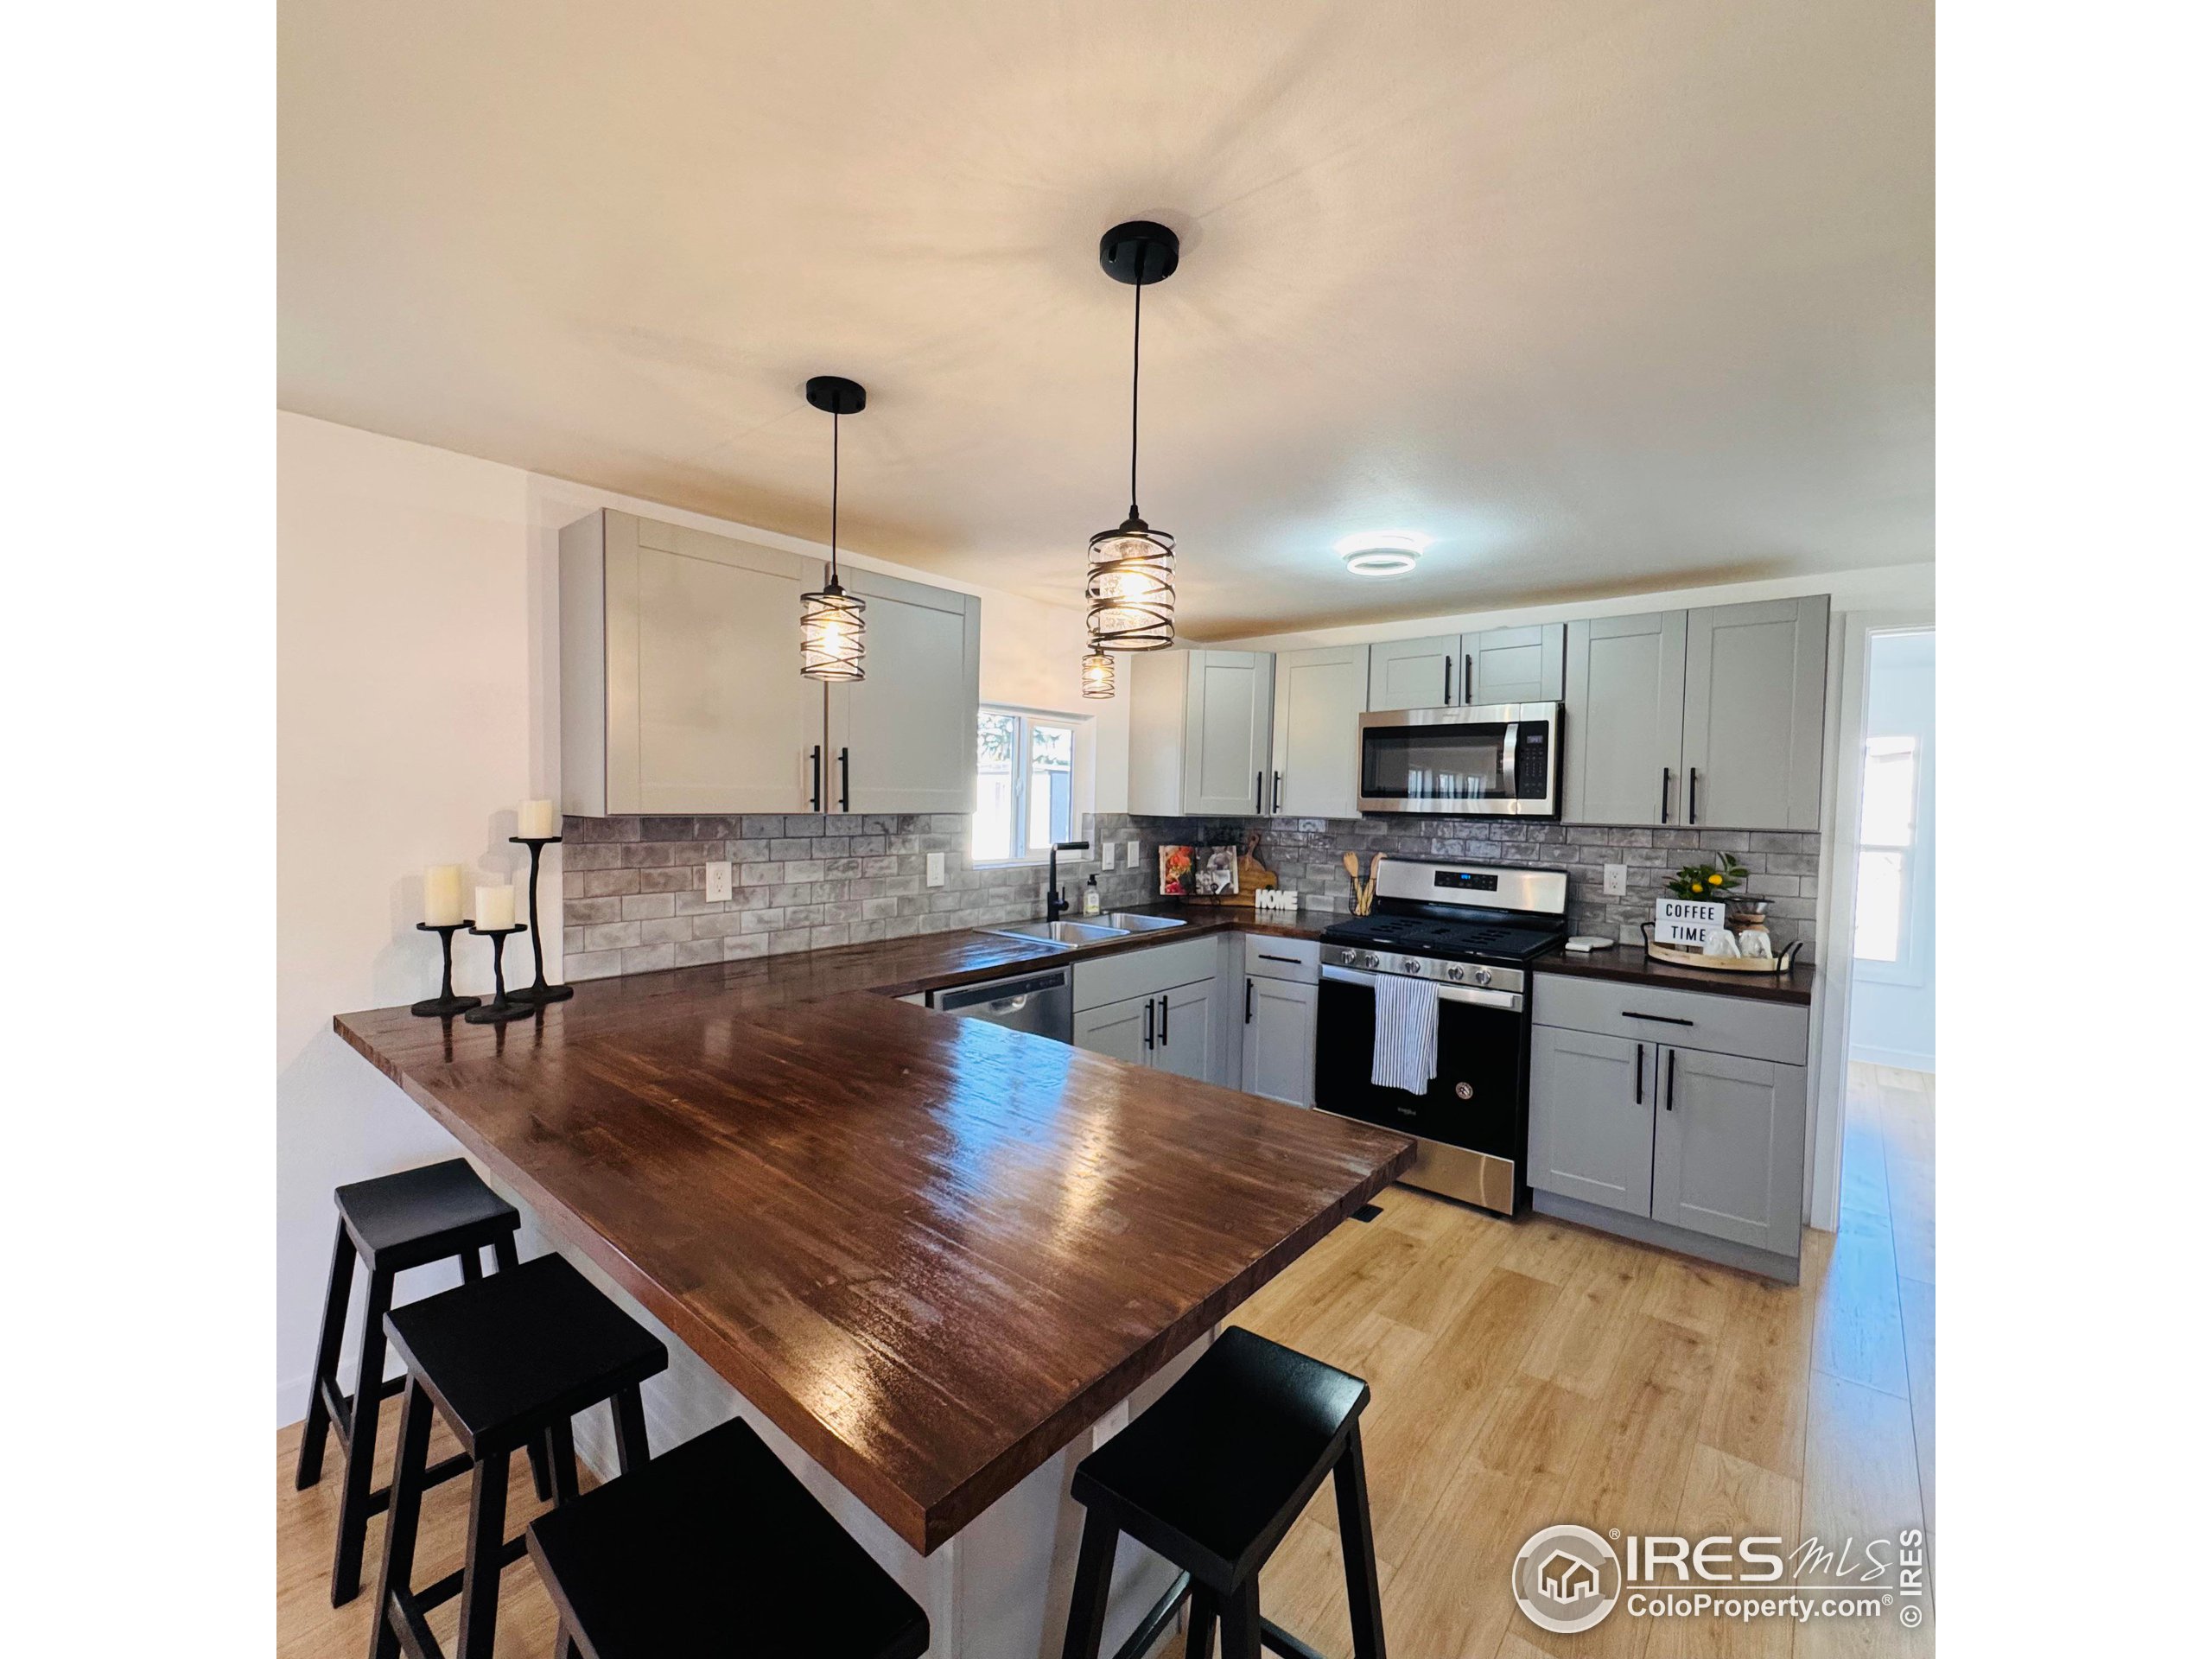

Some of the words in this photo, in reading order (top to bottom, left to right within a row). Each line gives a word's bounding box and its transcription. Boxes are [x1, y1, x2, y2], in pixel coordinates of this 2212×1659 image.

[1255, 888, 1298, 911] HOME
[1666, 903, 1714, 920] COFFEE
[1671, 925, 1706, 942] TIME
